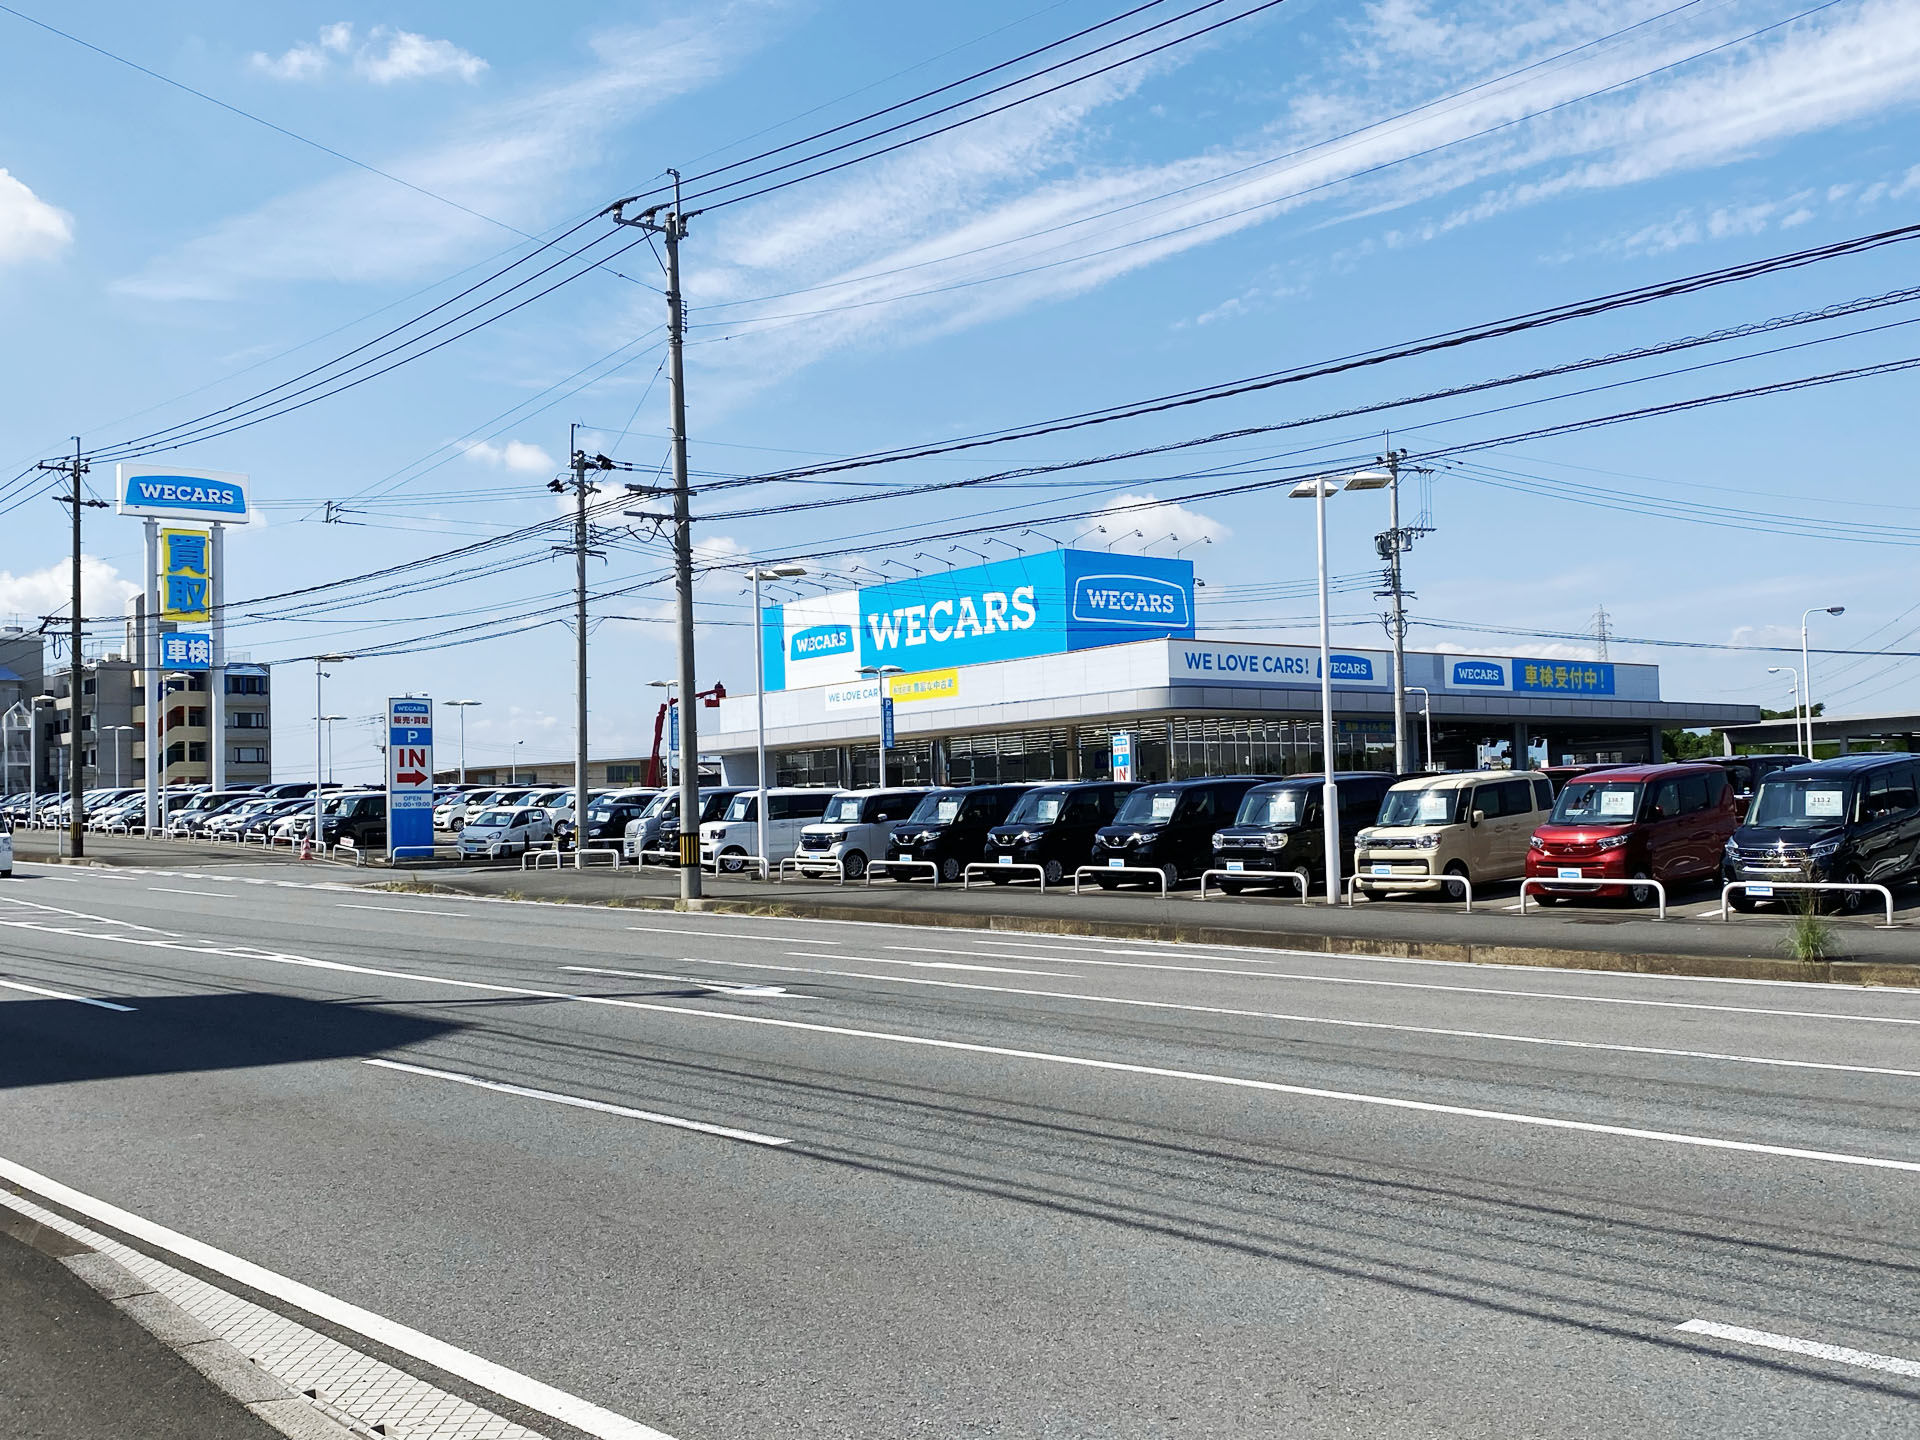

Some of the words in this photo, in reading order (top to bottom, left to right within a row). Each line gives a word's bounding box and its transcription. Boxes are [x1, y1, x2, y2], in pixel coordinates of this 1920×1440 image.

[139, 482, 235, 505] WECARS
[166, 534, 207, 614] 買取
[1086, 588, 1175, 614] WECARS
[868, 585, 1036, 651] WECARS
[166, 638, 210, 665] 車検
[796, 631, 847, 653] WECARS
[1185, 652, 1213, 671] WE
[1217, 653, 1259, 672] LOVE
[1262, 655, 1310, 675] CARS!
[1458, 667, 1499, 681] WECARS
[828, 693, 841, 703] WE
[842, 691, 861, 702] LOVE
[885, 700, 892, 709] P
[407, 730, 418, 743] P
[399, 748, 426, 768] IN
